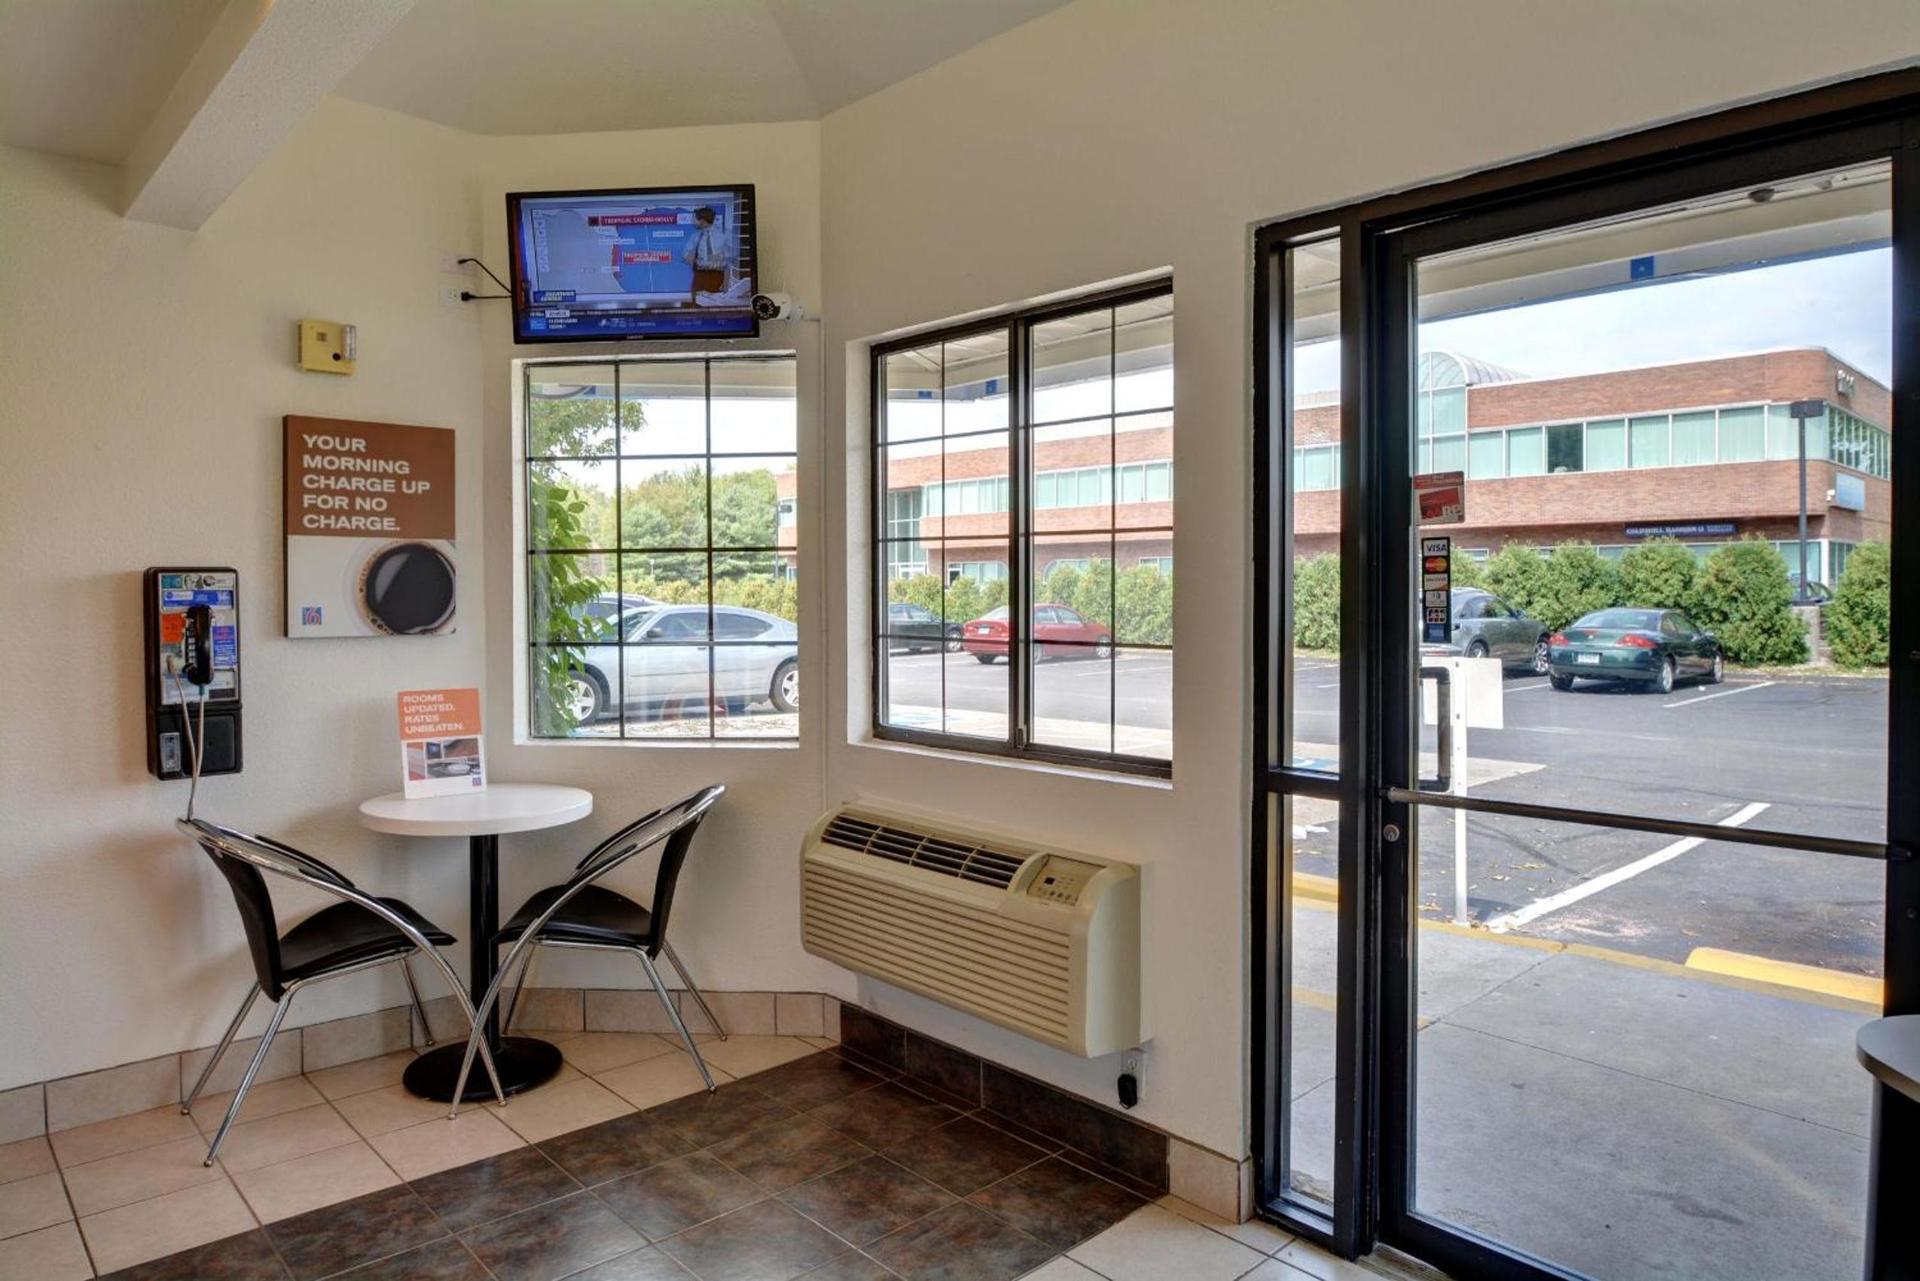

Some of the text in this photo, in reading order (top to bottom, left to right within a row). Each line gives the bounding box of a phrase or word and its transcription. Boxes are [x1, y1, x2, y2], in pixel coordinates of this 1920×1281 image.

[302, 434, 367, 453] YOUR
[302, 455, 411, 475] MORNING
[302, 474, 431, 495] CHARGE UP
[302, 494, 388, 512] FOR NO
[302, 514, 400, 532] CHARGE.
[1426, 543, 1447, 552] VISA
[403, 693, 444, 704] ROOMS
[403, 703, 456, 714] UPDATED.
[404, 713, 440, 724] RATES
[405, 722, 465, 734] UNBEATEN.
